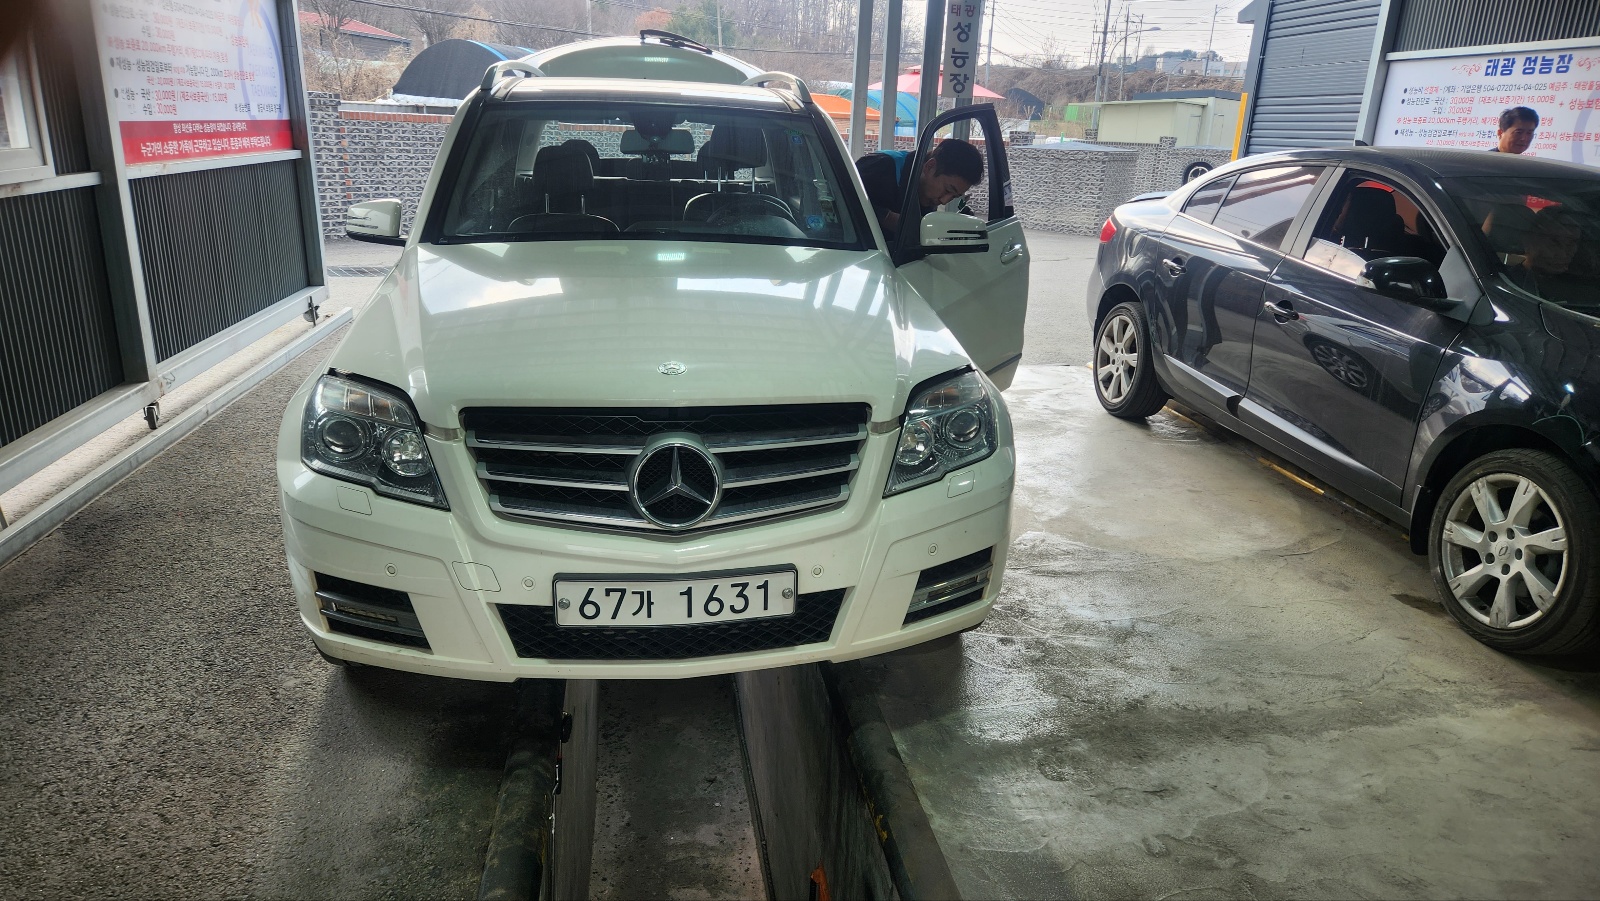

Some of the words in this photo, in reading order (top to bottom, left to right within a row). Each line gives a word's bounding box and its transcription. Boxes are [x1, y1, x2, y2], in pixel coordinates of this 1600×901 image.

[951, 4, 976, 17] 태광
[949, 21, 972, 94] 성능장
[1484, 57, 1516, 76] 태광
[1522, 53, 1573, 75] 성능장
[1483, 82, 1547, 92] 504-072014-04-025
[1549, 81, 1568, 92] 예금주
[141, 88, 151, 101] 국산
[155, 89, 176, 102] 30,000원
[143, 103, 153, 116] 수입
[156, 102, 178, 115] 30,000원
[1432, 107, 1443, 115] 수입
[1448, 106, 1473, 115] 30,000원
[140, 141, 163, 157] 누군가의
[163, 140, 179, 155] 소중한
[178, 139, 194, 154] 가족이
[193, 138, 213, 153] 근무하고
[579, 587, 655, 620] 67가
[679, 579, 769, 618] 1631
